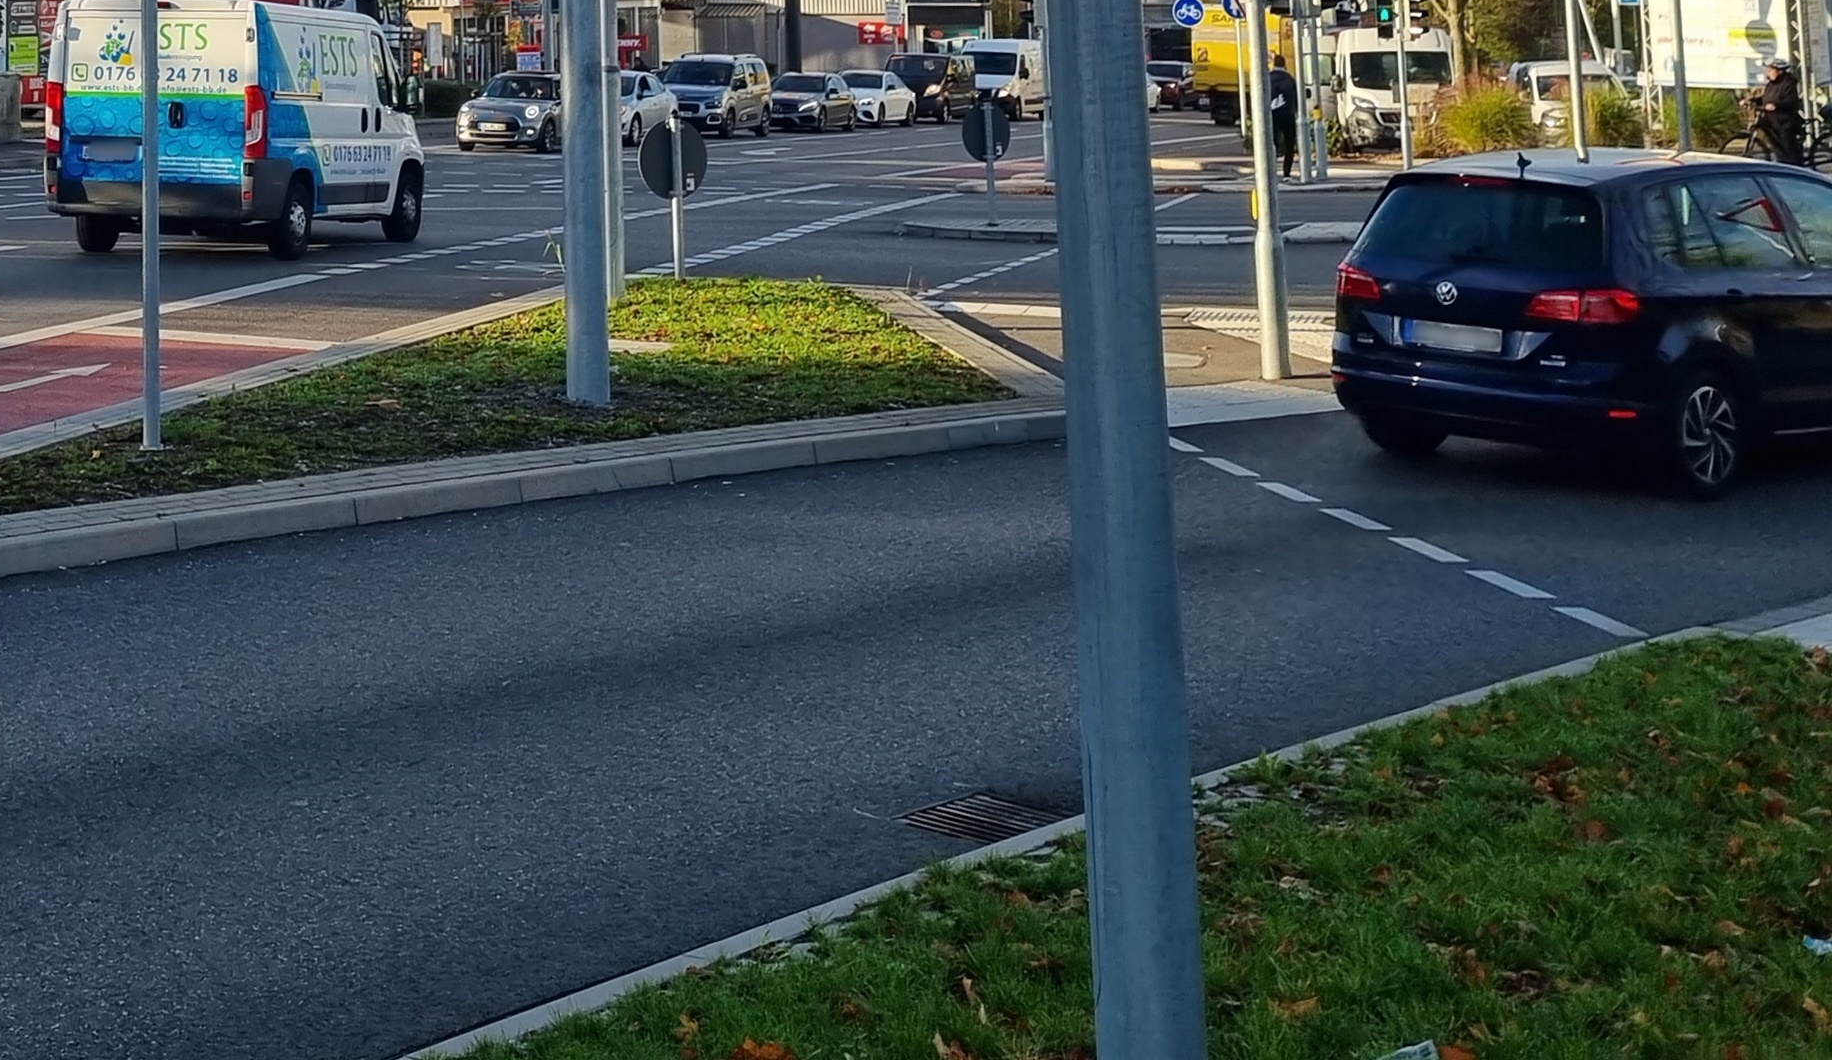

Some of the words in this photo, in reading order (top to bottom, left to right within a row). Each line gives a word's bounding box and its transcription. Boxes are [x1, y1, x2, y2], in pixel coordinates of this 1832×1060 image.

[158, 23, 208, 51] STS
[319, 34, 358, 77] ESTS
[94, 66, 136, 82] 0176
[165, 67, 187, 83] 24
[192, 68, 210, 83] 71
[218, 68, 239, 84] 18
